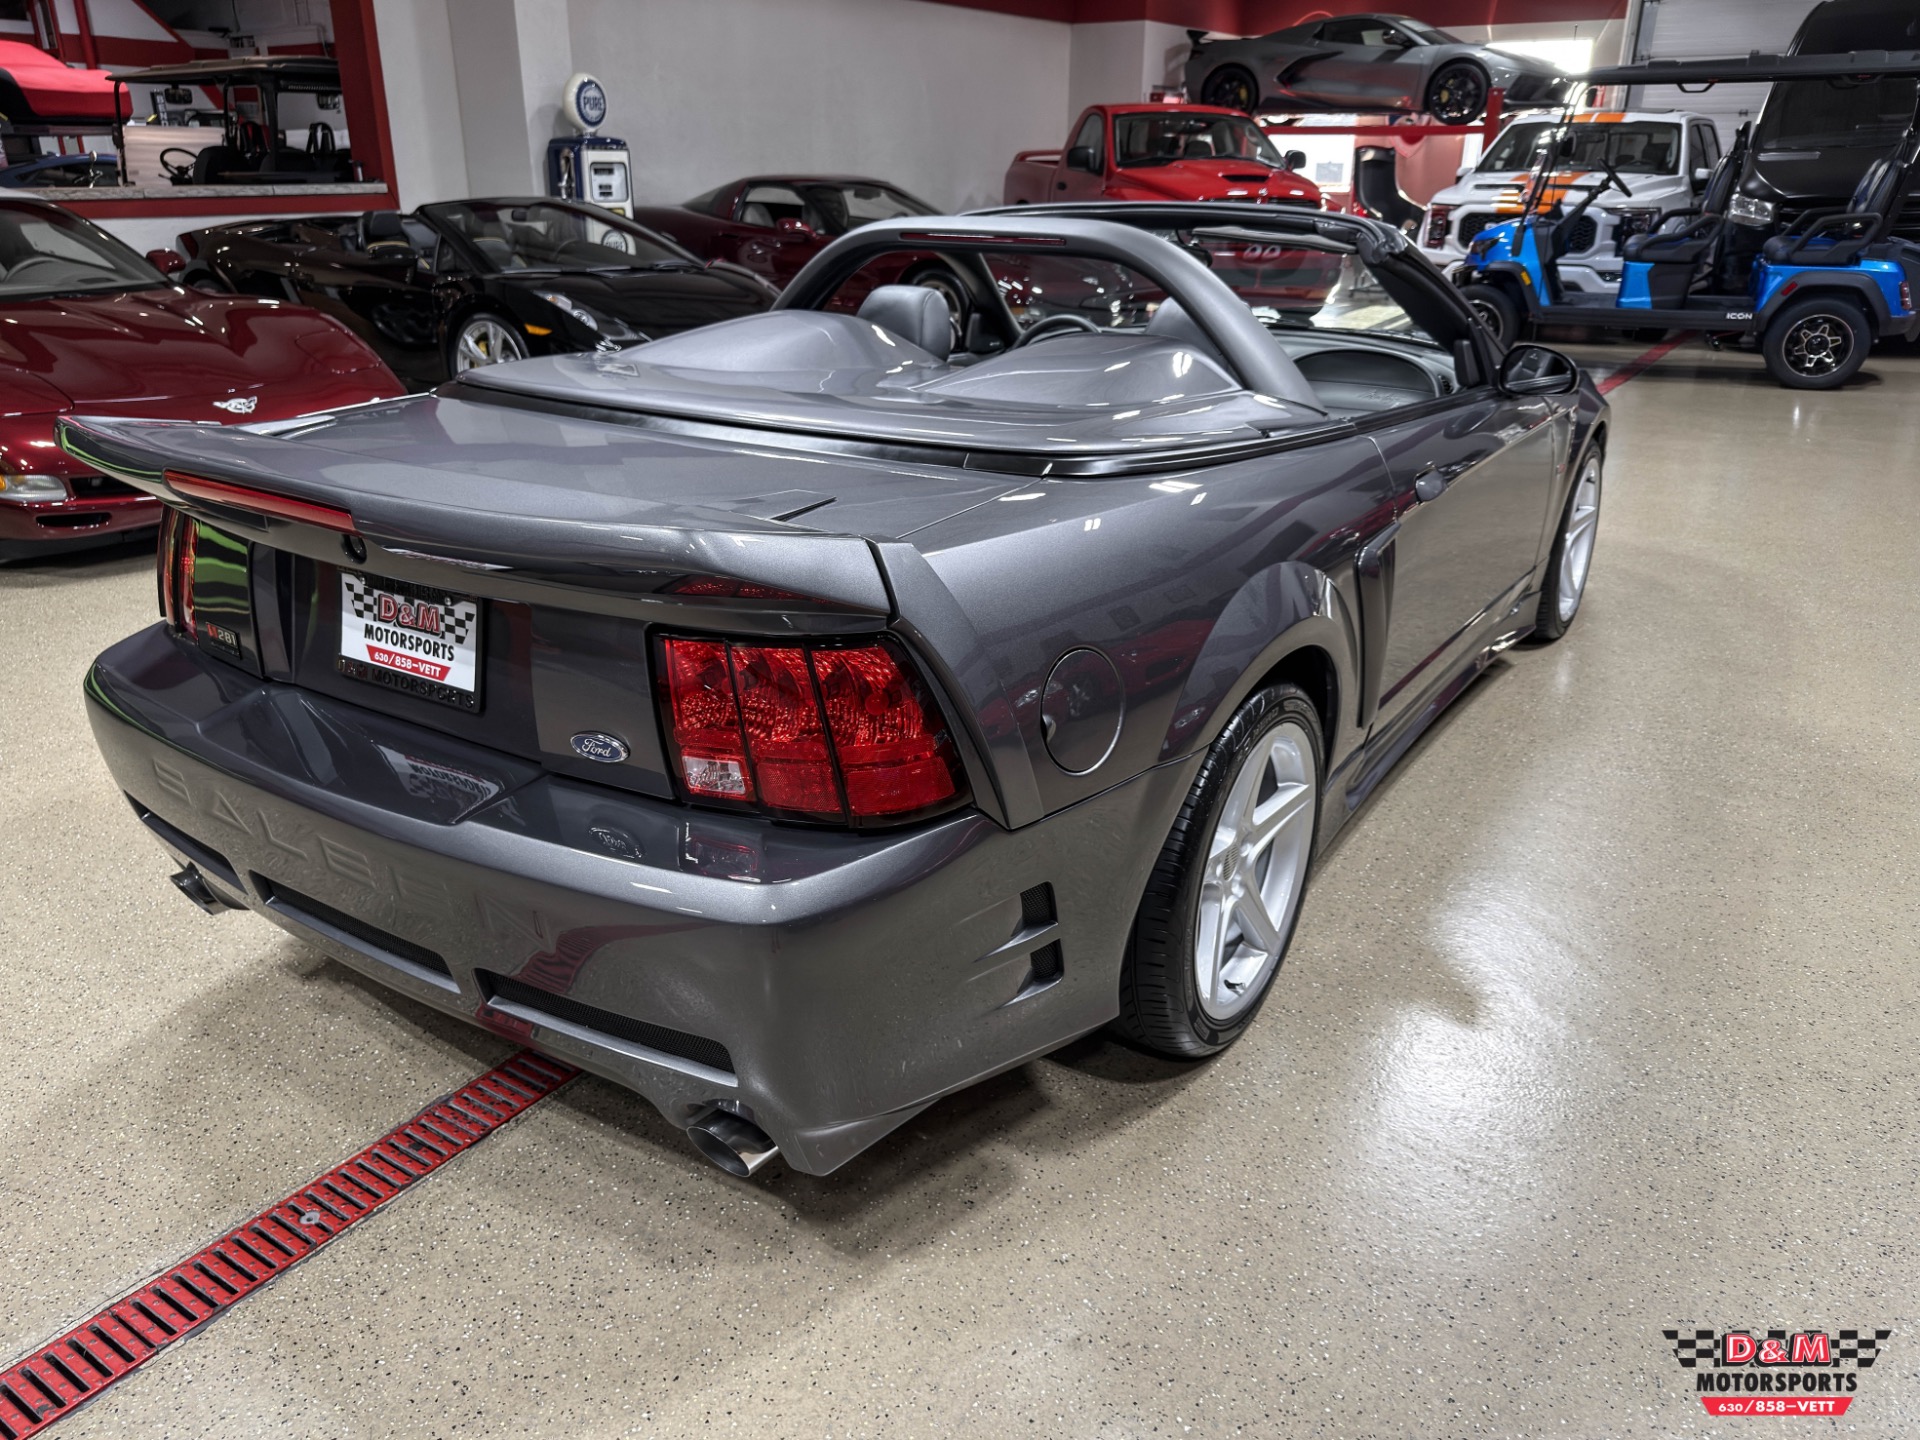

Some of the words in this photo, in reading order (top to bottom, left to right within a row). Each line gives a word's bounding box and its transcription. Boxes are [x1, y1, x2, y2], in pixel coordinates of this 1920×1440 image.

[583, 95, 603, 111] PURE
[1726, 312, 1753, 320] ICON
[379, 593, 441, 635] D&M
[364, 623, 455, 662] MOTORSPORTS
[371, 668, 474, 709] MOTORSPORTS
[581, 738, 612, 757] Ford
